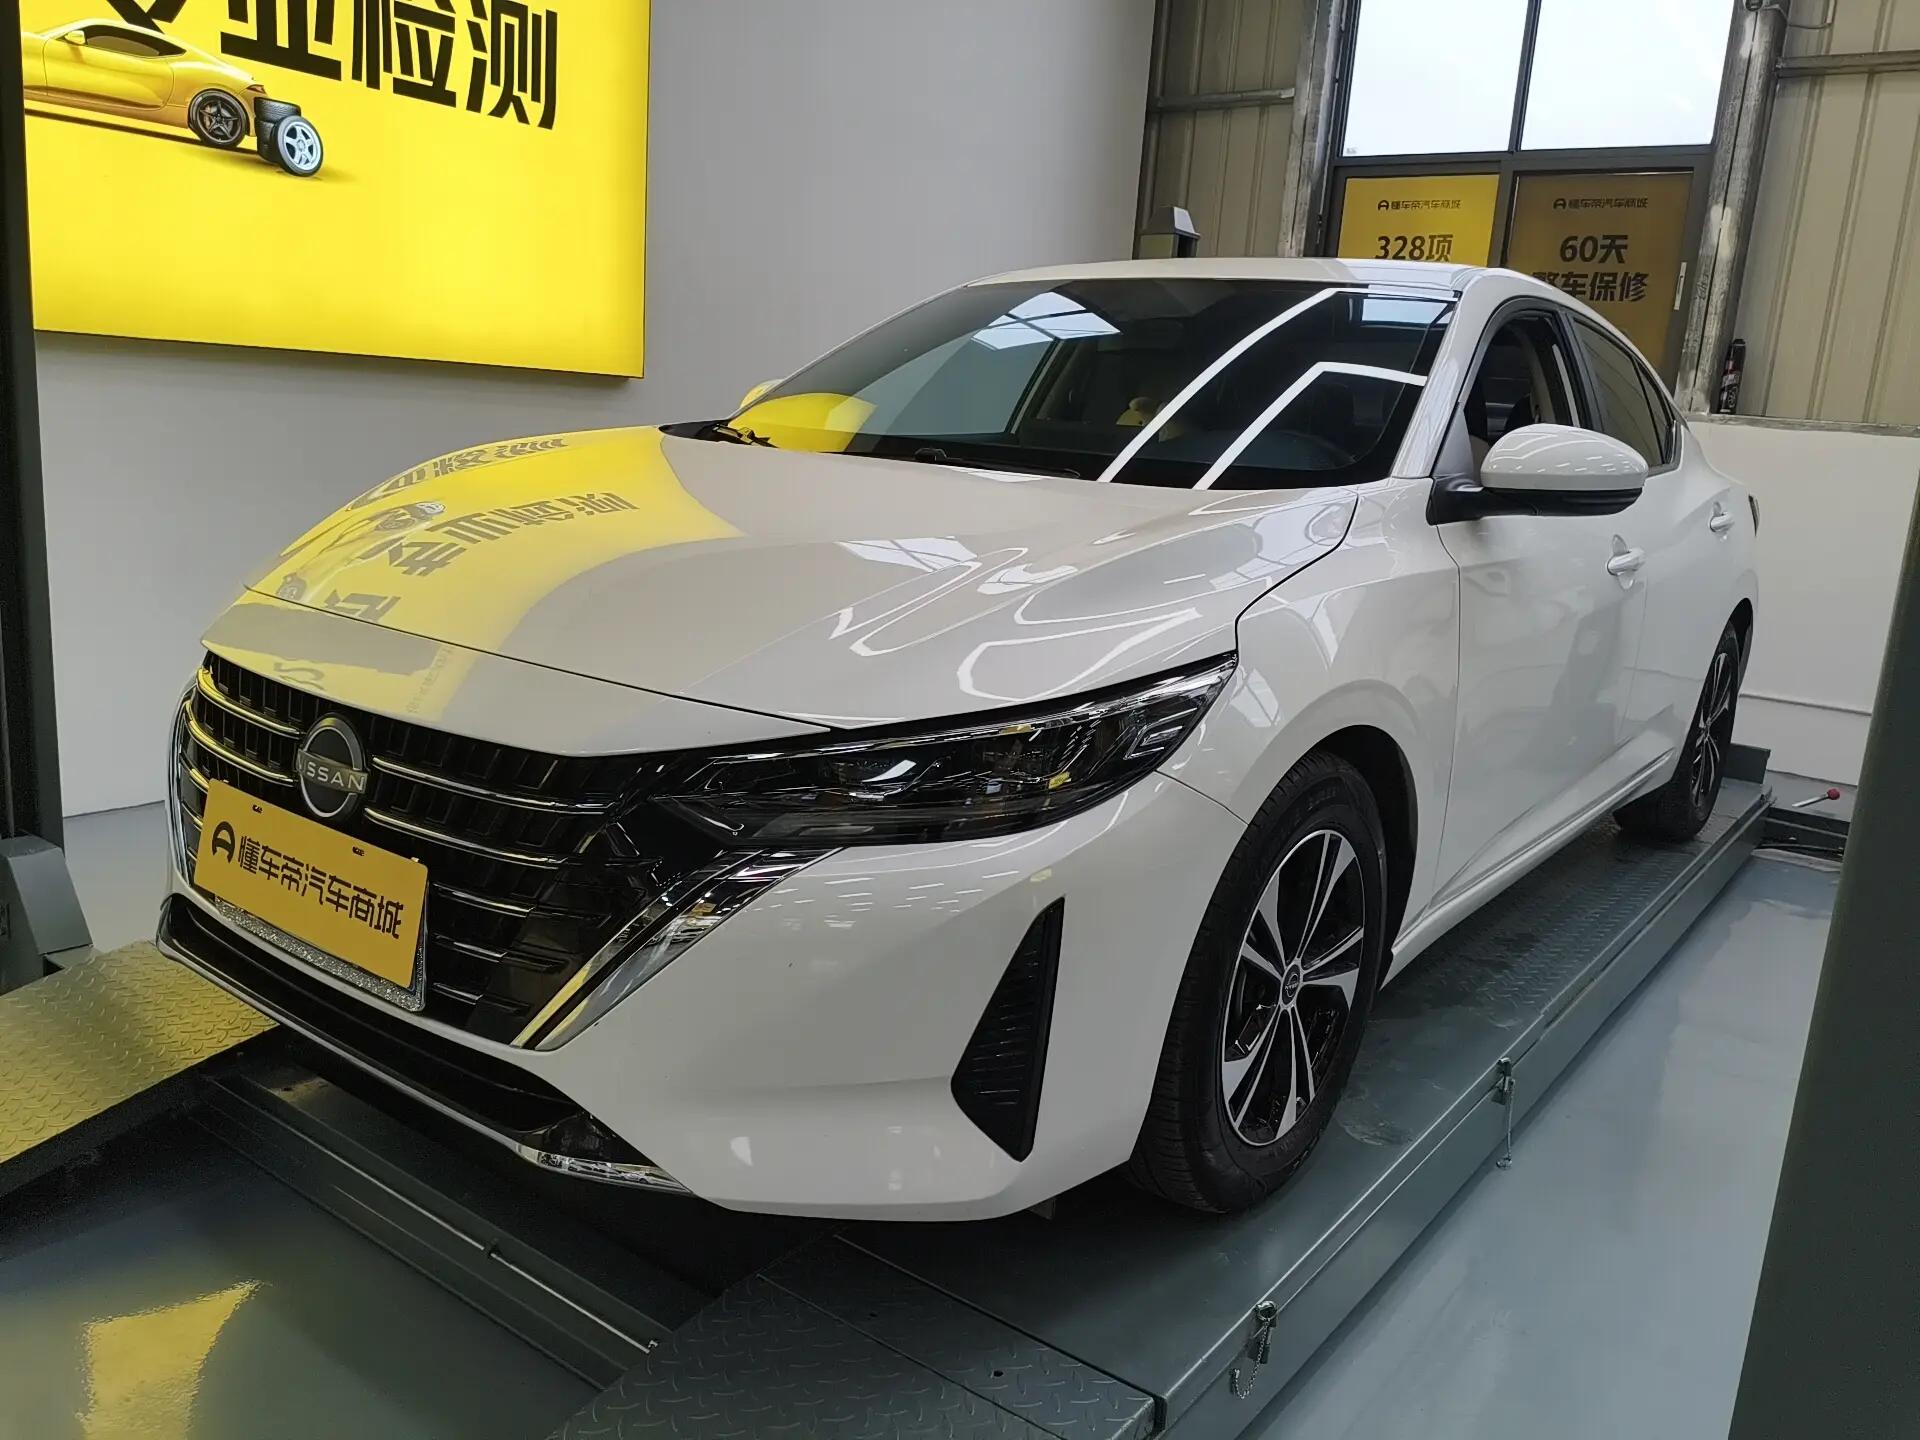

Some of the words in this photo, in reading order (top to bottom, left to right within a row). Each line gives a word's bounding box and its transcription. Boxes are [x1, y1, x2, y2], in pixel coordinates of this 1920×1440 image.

[1559, 235, 1629, 264] 60天
[238, 836, 404, 938] 懂车帝汽车商城
